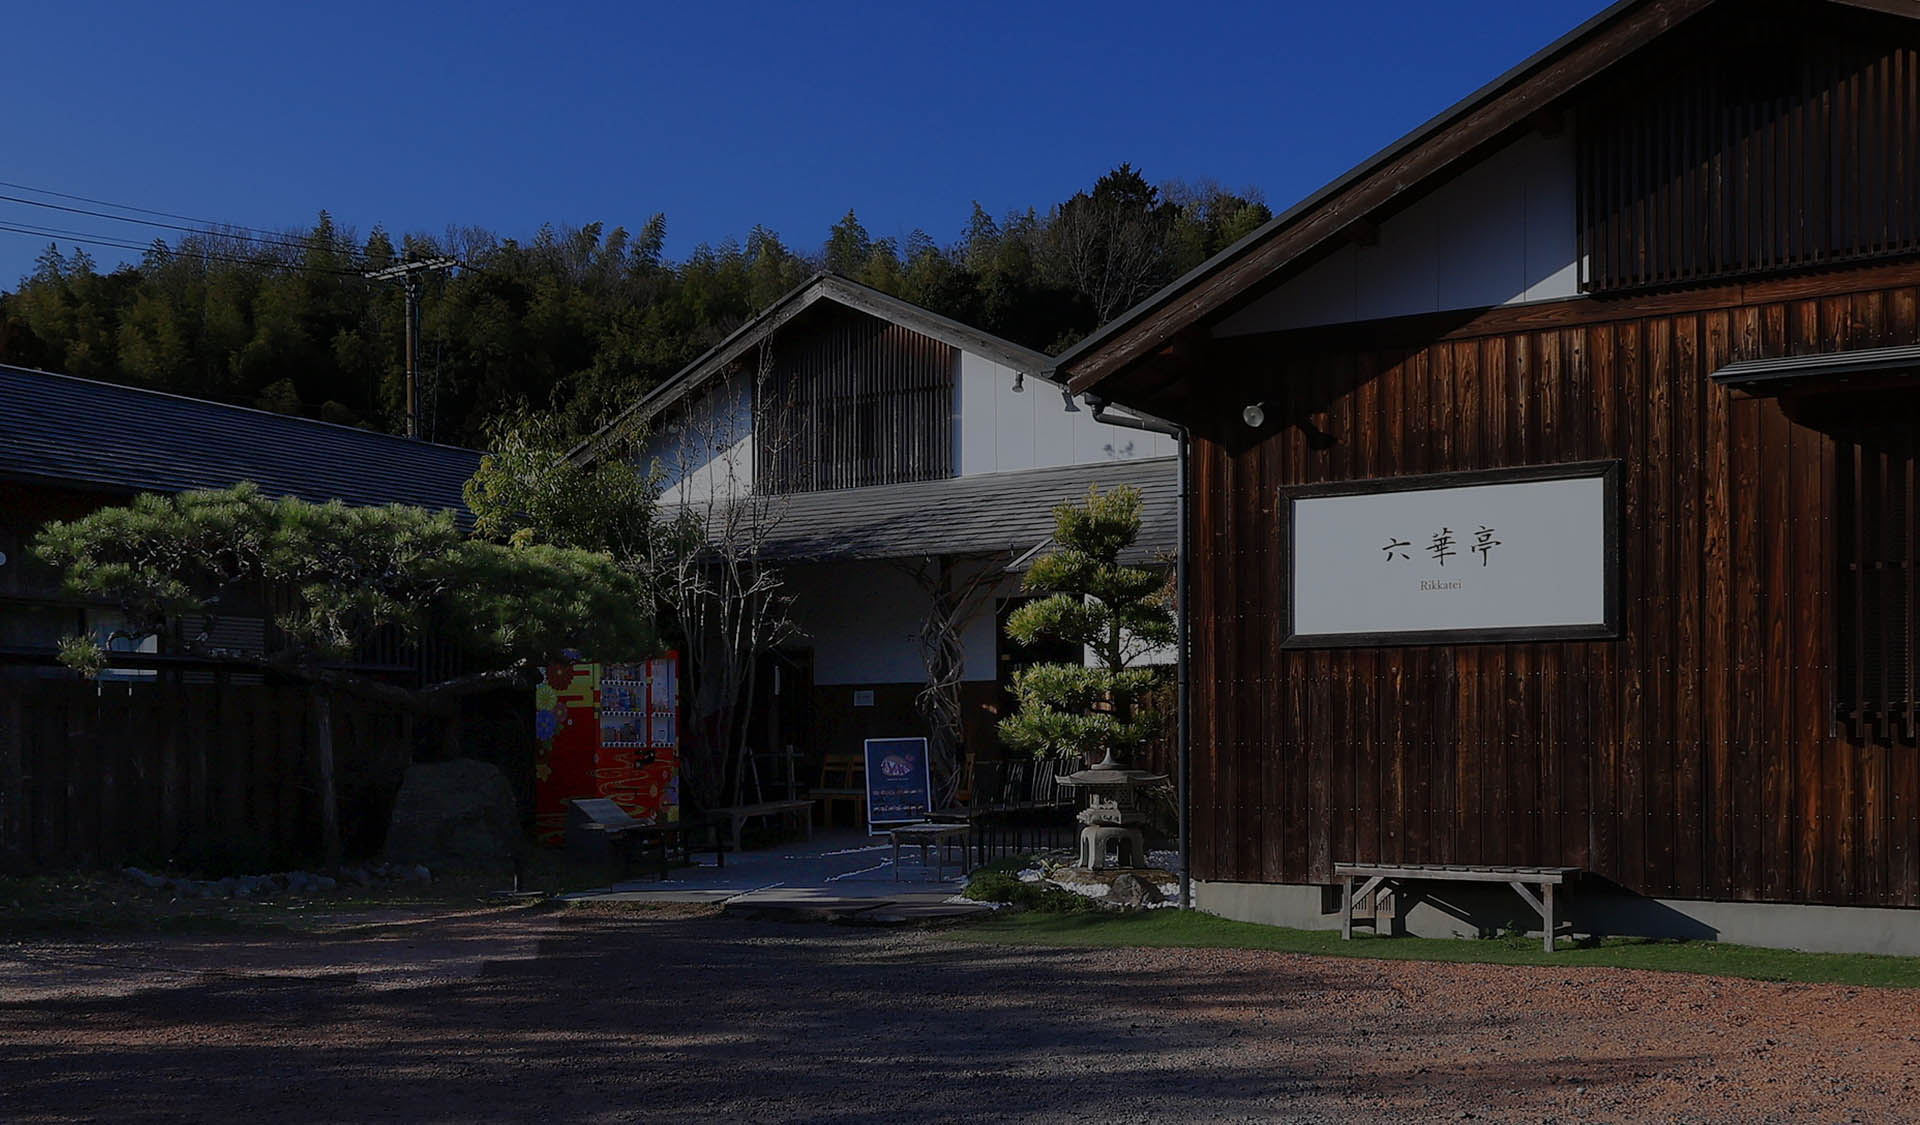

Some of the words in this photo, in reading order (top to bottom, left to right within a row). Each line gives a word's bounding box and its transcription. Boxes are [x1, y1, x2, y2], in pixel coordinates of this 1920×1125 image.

[1381, 525, 1502, 567] 六華亭
[1420, 579, 1462, 592] Rikkatei
